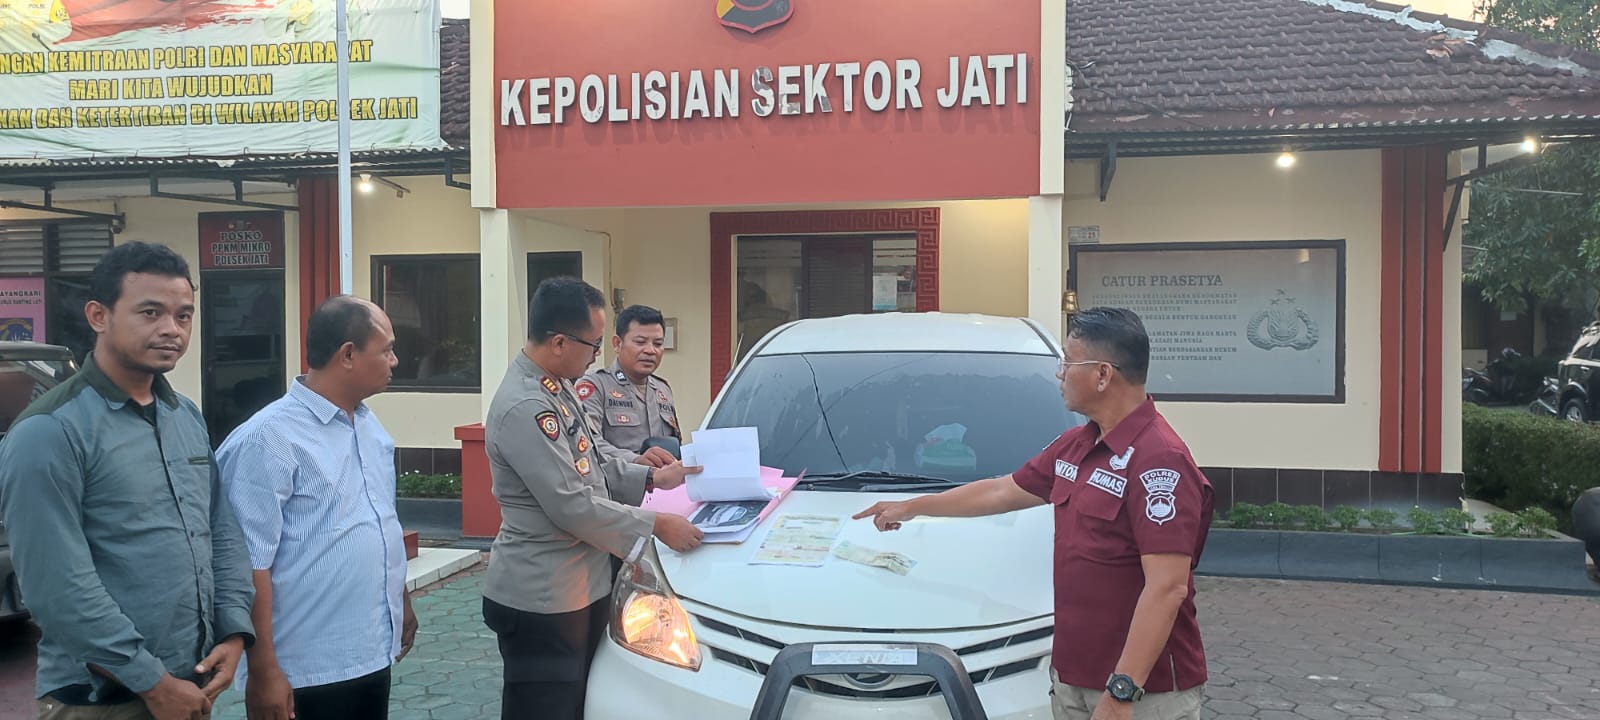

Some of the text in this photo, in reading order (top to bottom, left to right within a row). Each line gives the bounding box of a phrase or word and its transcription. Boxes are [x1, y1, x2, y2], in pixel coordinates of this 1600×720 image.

[0, 39, 373, 74] NGAN KEMITRAAN POLRI DAN MASYARAAT
[69, 73, 273, 100] MARI KITA WUJUDKAN
[500, 53, 1028, 126] KEPOLISIAN SEKTOR JATI
[36, 106, 72, 128] DAN
[76, 104, 187, 128] KETERTIBAN
[190, 103, 212, 125] DI
[215, 101, 299, 124] WILAYAH
[302, 99, 376, 121] POLEK
[378, 97, 418, 120] JATI
[211, 241, 271, 254] PPKM MIKRO
[215, 255, 250, 266] POLSEK
[1101, 274, 1223, 287] CATUR PRASETYA
[1092, 470, 1124, 493] HUMAS
[1144, 471, 1178, 481] POLRES
